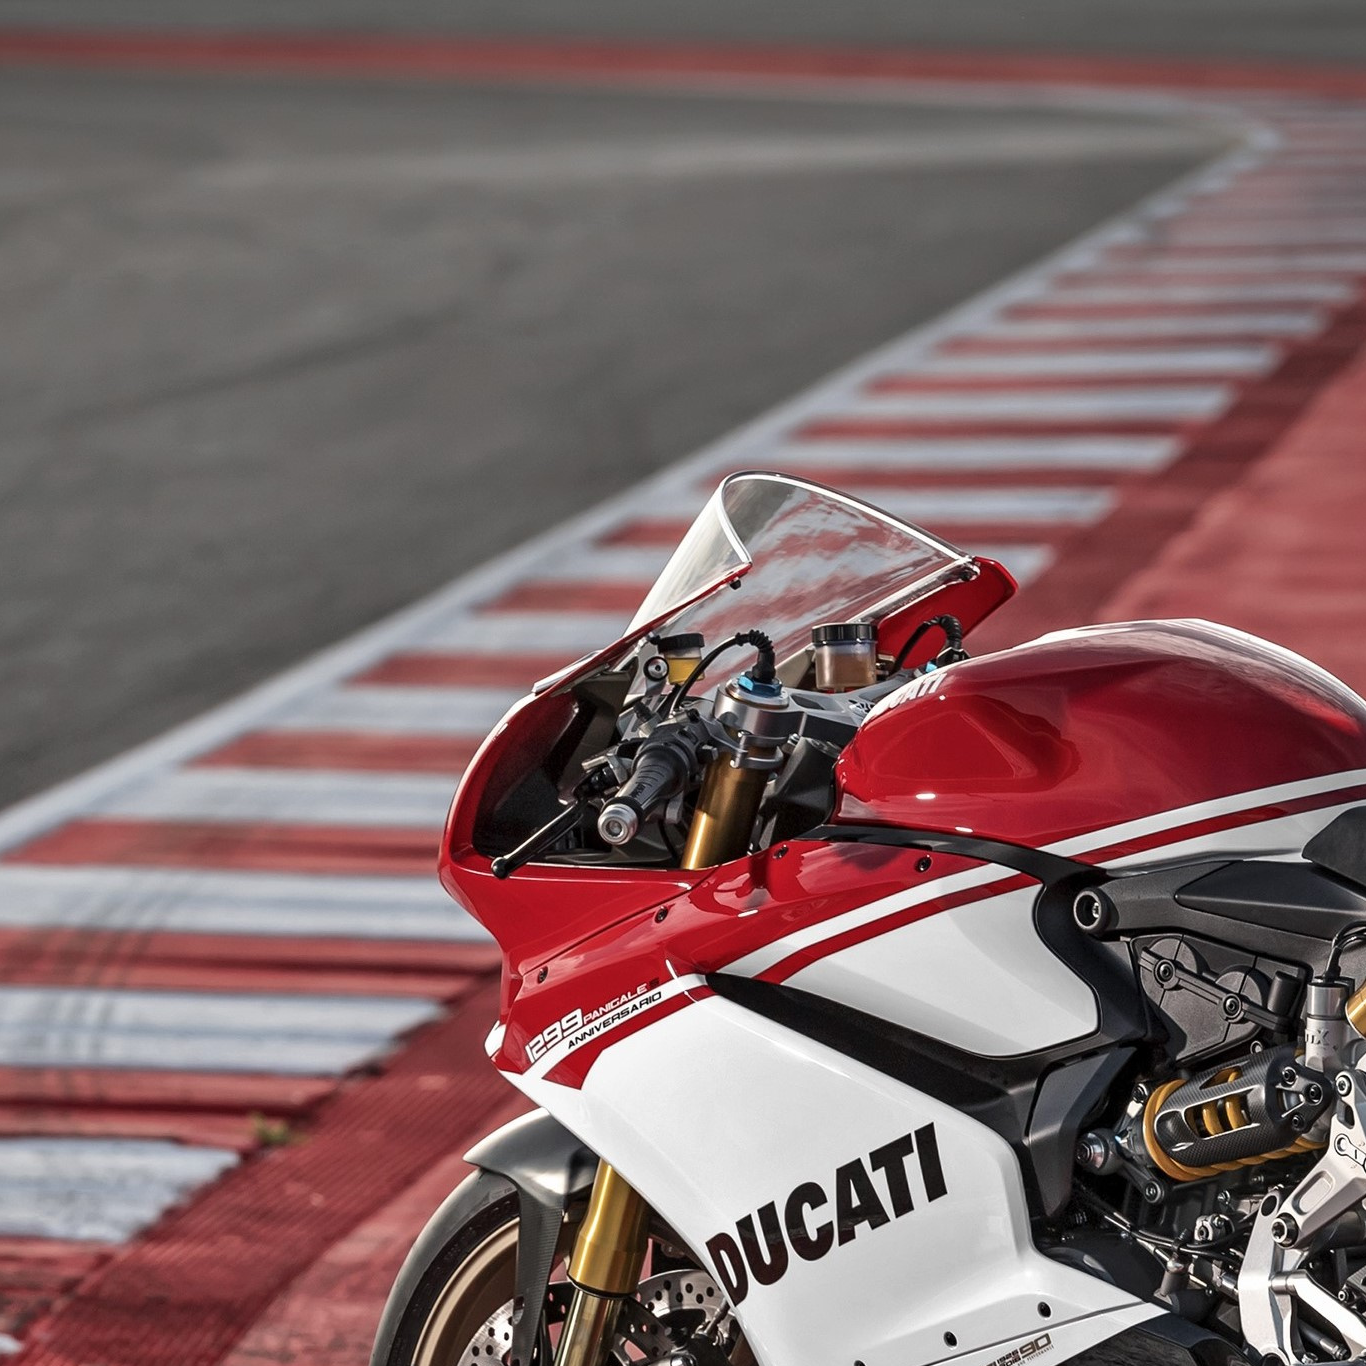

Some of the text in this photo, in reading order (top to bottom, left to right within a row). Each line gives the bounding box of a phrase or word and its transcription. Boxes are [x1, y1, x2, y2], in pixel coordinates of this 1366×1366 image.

[525, 1007, 584, 1064] 1299
[584, 983, 647, 1024] PANIGALE
[568, 991, 662, 1049] ANNIVERSARIO
[705, 1121, 948, 1308] DUCATI
[1019, 1332, 1052, 1359] 90
